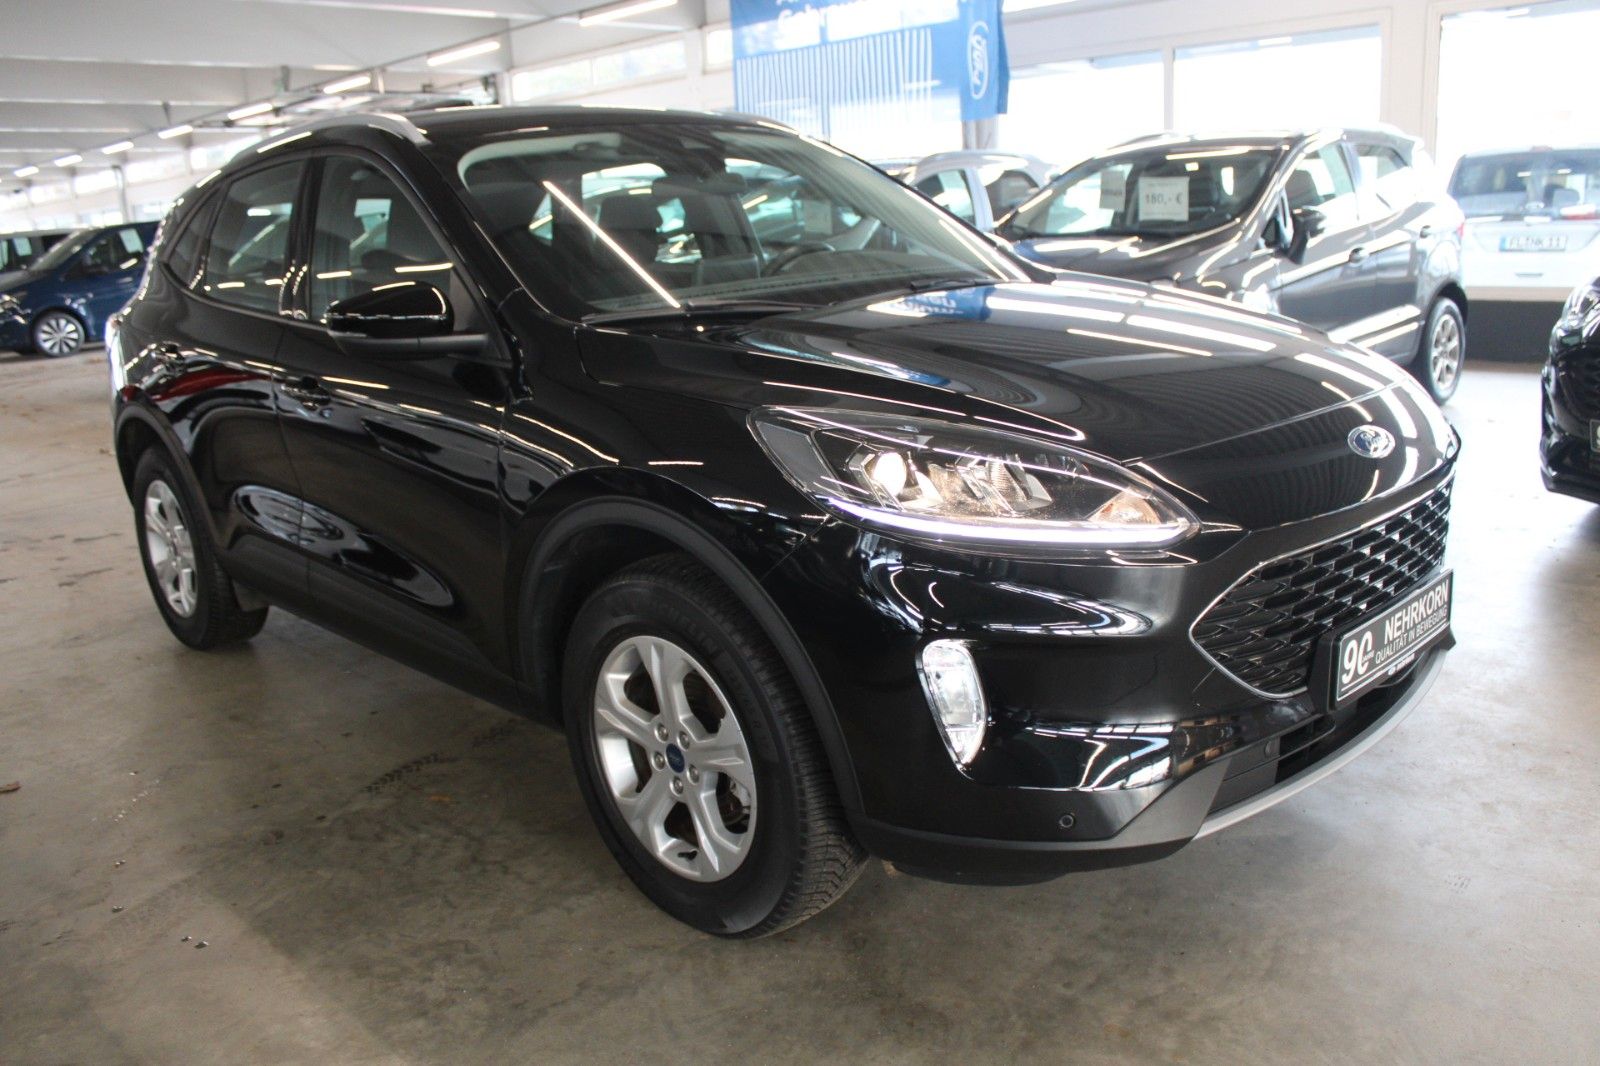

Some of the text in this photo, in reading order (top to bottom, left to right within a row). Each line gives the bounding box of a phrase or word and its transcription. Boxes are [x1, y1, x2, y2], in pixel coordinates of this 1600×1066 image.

[1375, 632, 1408, 664] QUALITÄT
[1409, 626, 1416, 642] IN
[1416, 604, 1448, 637] BEWEGUNG
[1384, 579, 1449, 645] NEHRKORN
